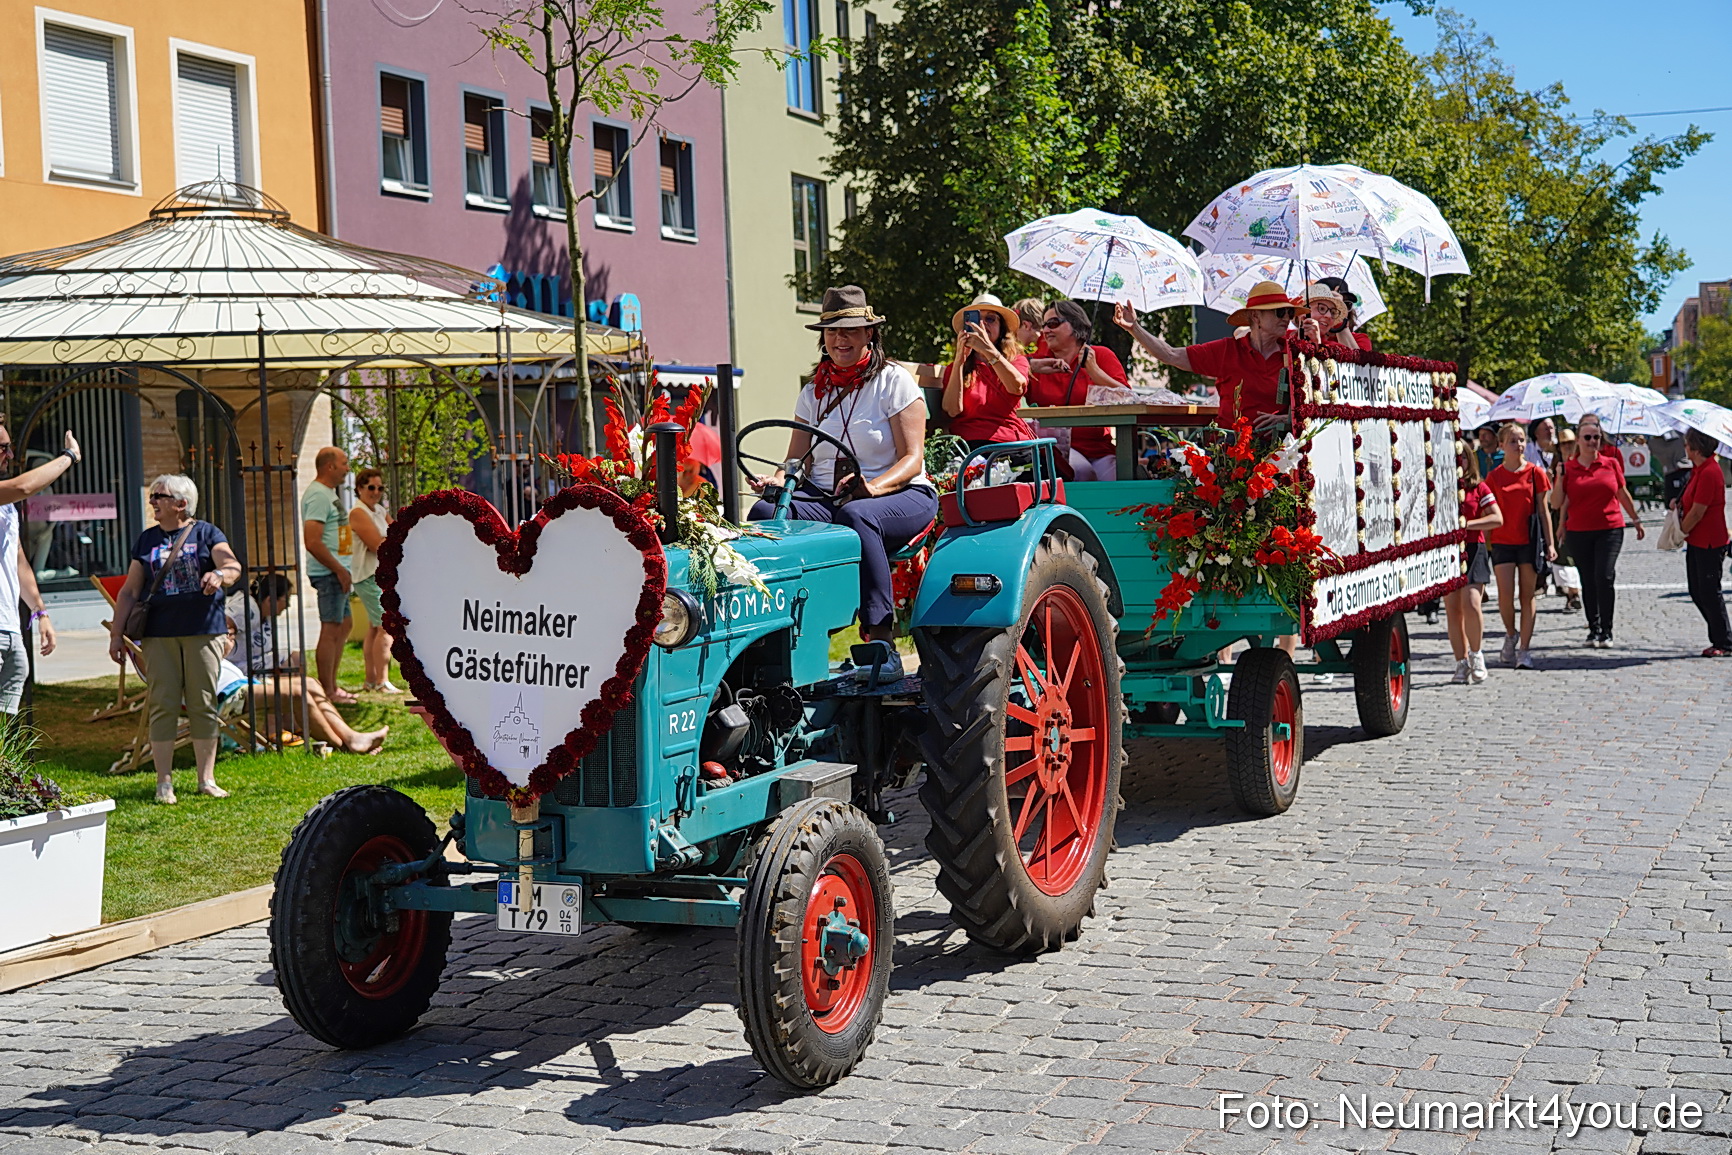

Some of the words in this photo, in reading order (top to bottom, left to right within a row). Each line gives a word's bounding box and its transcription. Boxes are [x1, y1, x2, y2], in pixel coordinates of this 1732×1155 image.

[1330, 575, 1343, 615] da
[1346, 576, 1380, 610] samma
[1430, 550, 1449, 581] dabei
[463, 598, 577, 638] Neimaker
[700, 588, 785, 625] ANOMAG
[445, 646, 591, 689] Gästeführer
[669, 713, 679, 735] R
[681, 709, 696, 732] 22
[502, 895, 509, 903] D
[508, 908, 548, 930] T79
[559, 909, 572, 920] 04
[560, 923, 572, 933] 10
